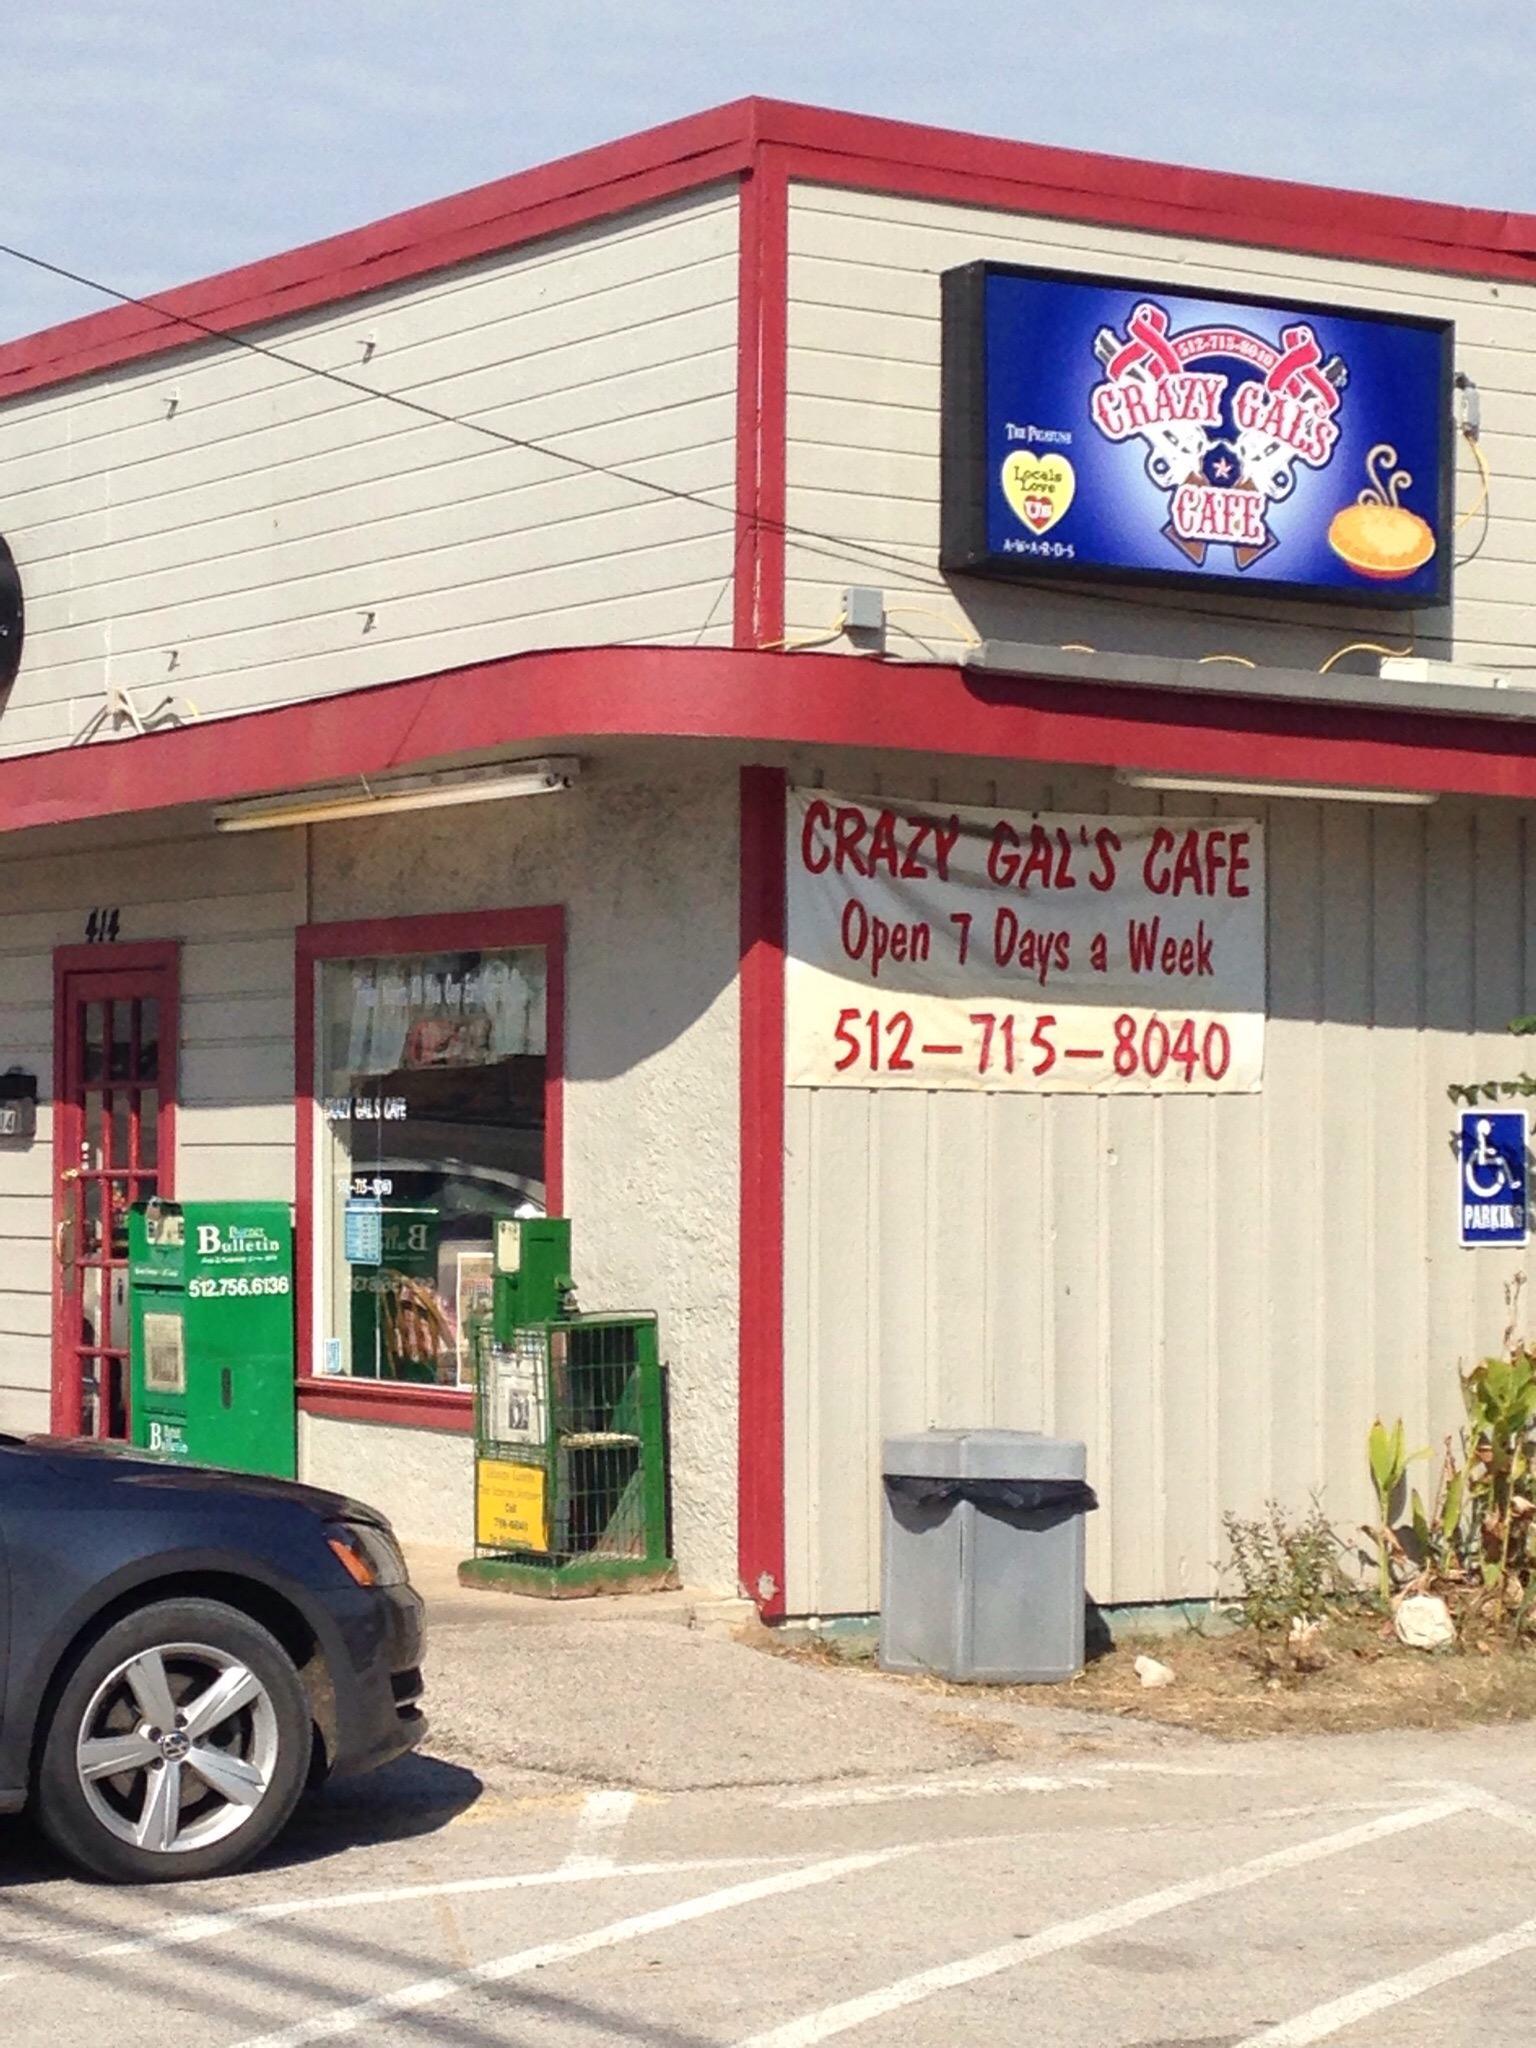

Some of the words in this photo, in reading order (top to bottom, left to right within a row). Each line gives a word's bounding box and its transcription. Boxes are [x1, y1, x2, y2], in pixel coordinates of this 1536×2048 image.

[1096, 376, 1222, 435] CRAZY
[1014, 465, 1062, 483] Locals
[1020, 479, 1056, 493] Love
[1176, 488, 1262, 538] CAFE
[802, 799, 960, 882] CRAZY
[986, 821, 1122, 892] GAL'S
[1142, 828, 1250, 897] CAFE
[85, 906, 120, 944] 414
[841, 898, 930, 977] Open
[950, 911, 972, 966] 7
[994, 907, 1070, 986] Days
[1090, 932, 1108, 972] a
[1129, 916, 1214, 976] Week
[834, 1007, 1232, 1082] 512-715-8040
[196, 1225, 281, 1255] Bulletin
[188, 1275, 290, 1298] 512.756.6136
